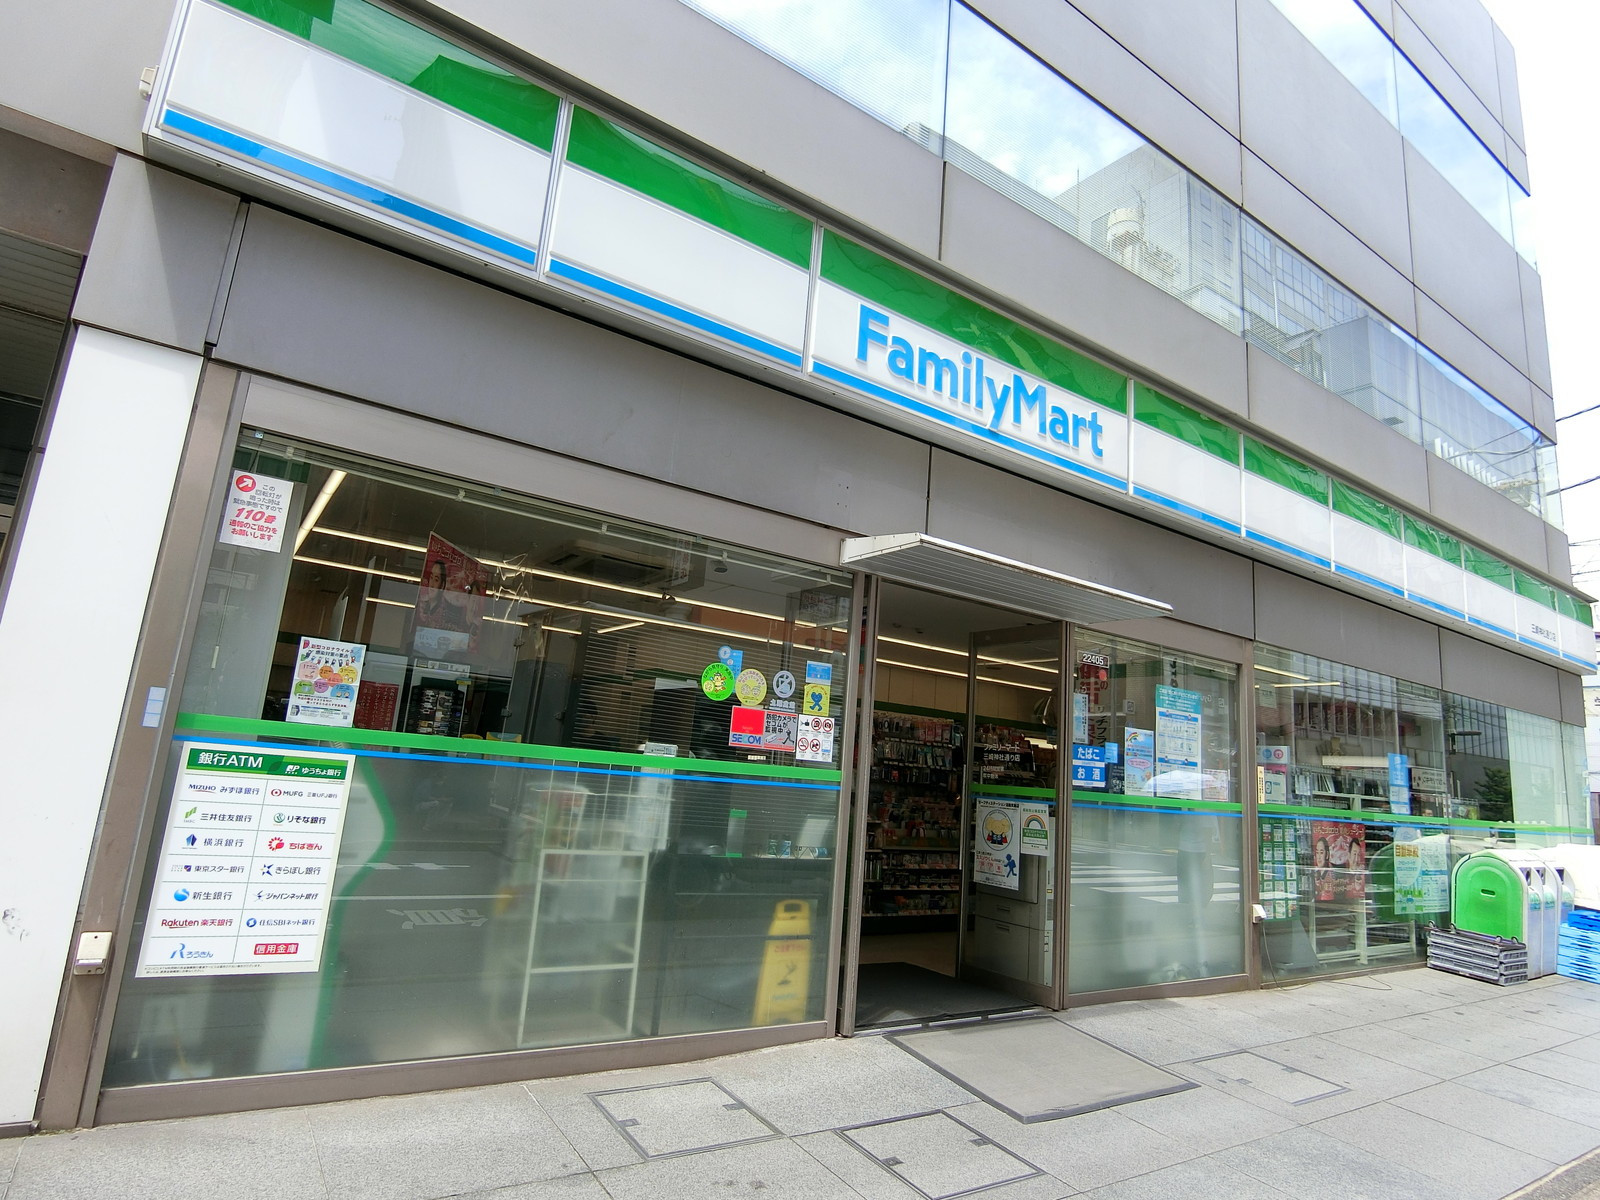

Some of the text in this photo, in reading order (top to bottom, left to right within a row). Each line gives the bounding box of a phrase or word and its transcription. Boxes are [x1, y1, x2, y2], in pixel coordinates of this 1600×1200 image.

[856, 303, 1104, 457] FamilyMart
[262, 484, 276, 492] この
[235, 507, 277, 524] 110番
[229, 519, 278, 535] 通報のご協力を
[231, 528, 273, 541] お願いします
[1083, 653, 1105, 666] 22405
[766, 713, 798, 724] 防犯カメラで
[765, 725, 784, 734] 監視中
[766, 720, 789, 729] セコムが
[731, 733, 761, 745] SECOM
[1078, 747, 1101, 760] たばこ
[197, 751, 263, 768] 銀行ATM
[301, 767, 342, 777] ゆうちょ銀行
[1077, 770, 1101, 781] お酒
[188, 783, 260, 796] MIZUHO みずほ銀行
[282, 790, 304, 798] MUFG
[200, 812, 253, 824] 三井住友銀行
[286, 815, 327, 825] りそな銀行
[203, 838, 244, 848] 横浜銀行
[288, 842, 323, 851] ちばぎん
[194, 865, 245, 874] 東京スター銀行
[275, 865, 321, 876] きらぼし銀行
[192, 891, 233, 901] 新生銀行
[265, 892, 319, 901] ジャパンネット銀行
[161, 918, 233, 929] Rakuten 楽天銀行
[259, 918, 316, 927] 住信SBIネット銀行
[186, 951, 214, 959] ろうきん
[255, 944, 298, 955] 信用金庫
